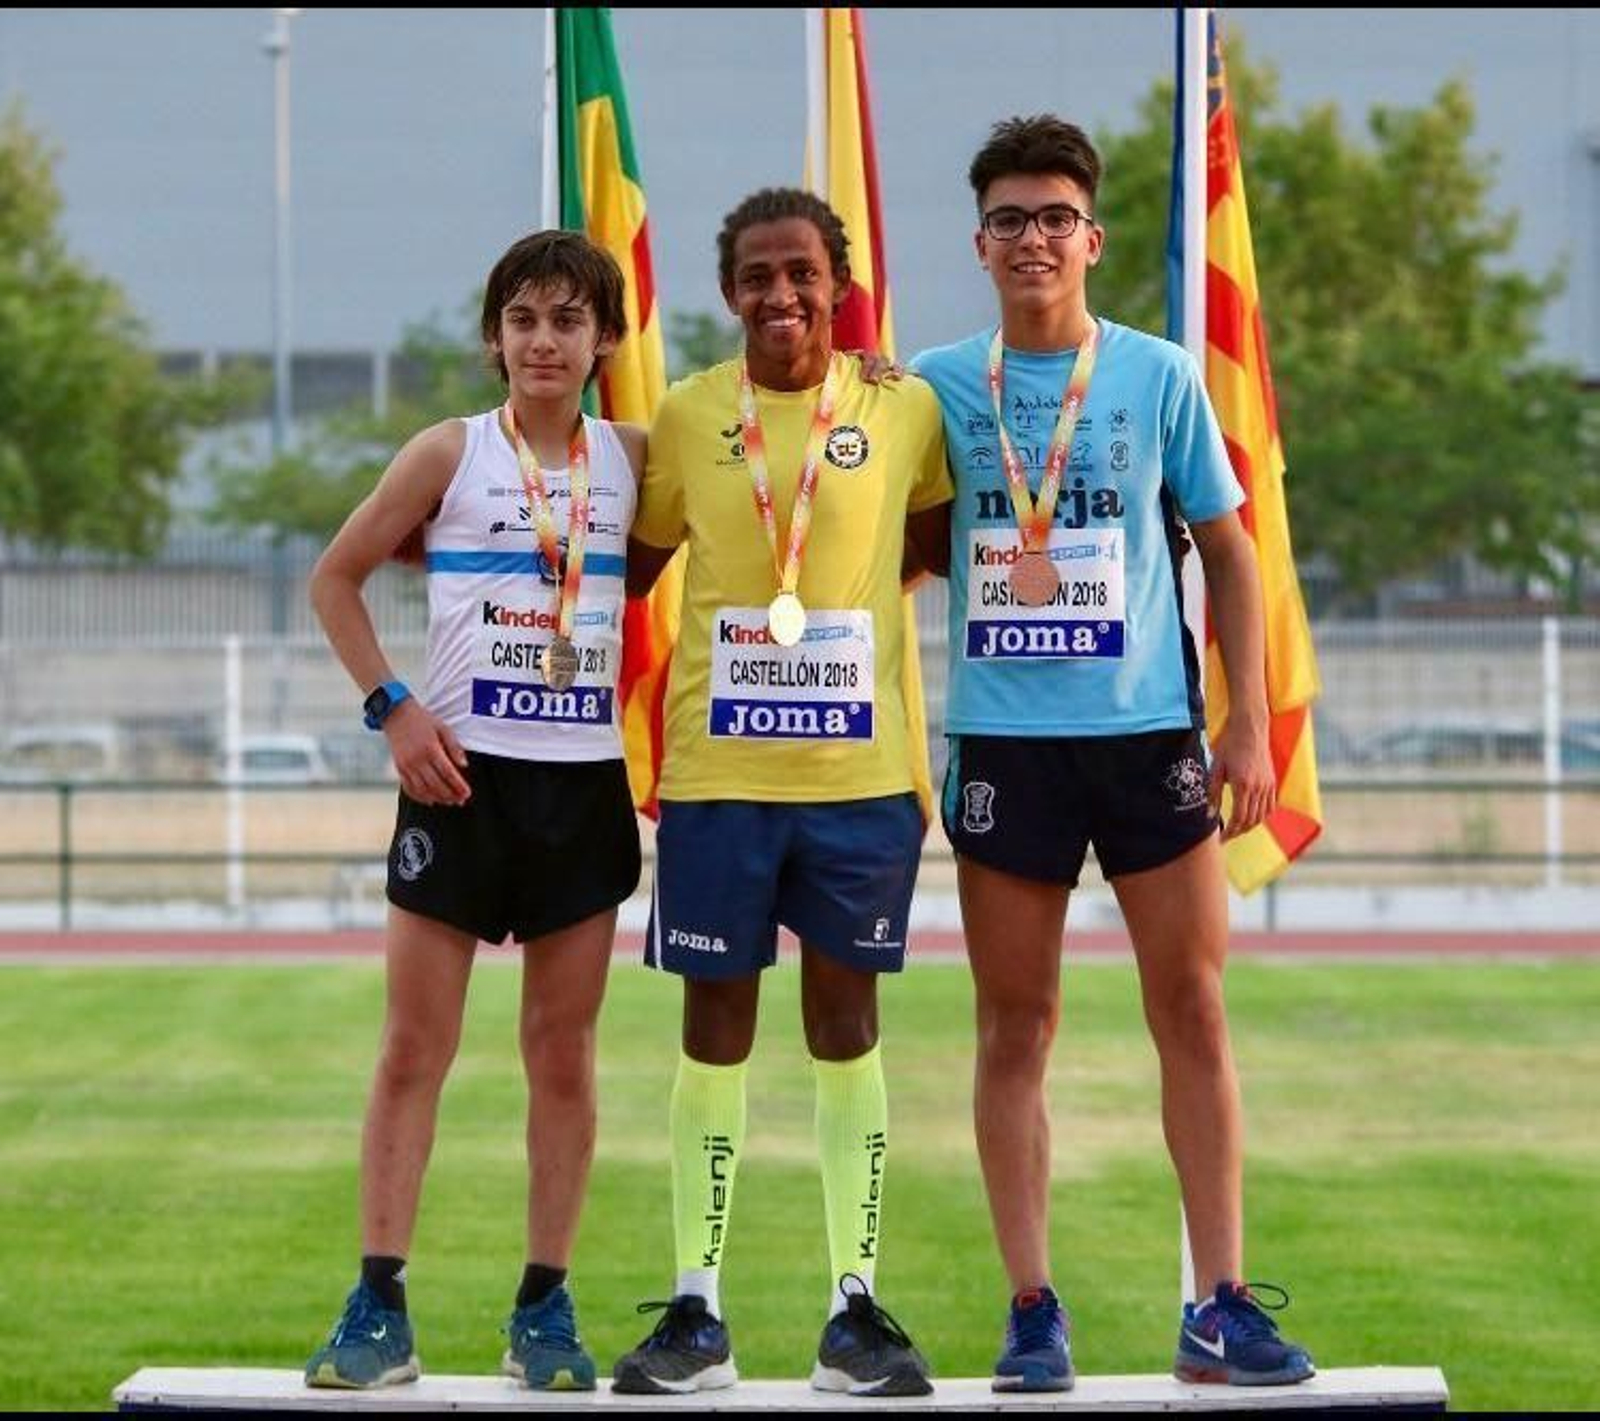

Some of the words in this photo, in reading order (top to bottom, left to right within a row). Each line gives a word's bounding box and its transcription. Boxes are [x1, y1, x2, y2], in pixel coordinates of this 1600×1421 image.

[975, 477, 1124, 529] nrja
[1072, 581, 1107, 607] 2018
[730, 654, 820, 687] CASTELLÓN
[824, 662, 858, 688] 2018
[668, 928, 728, 952] Joma
